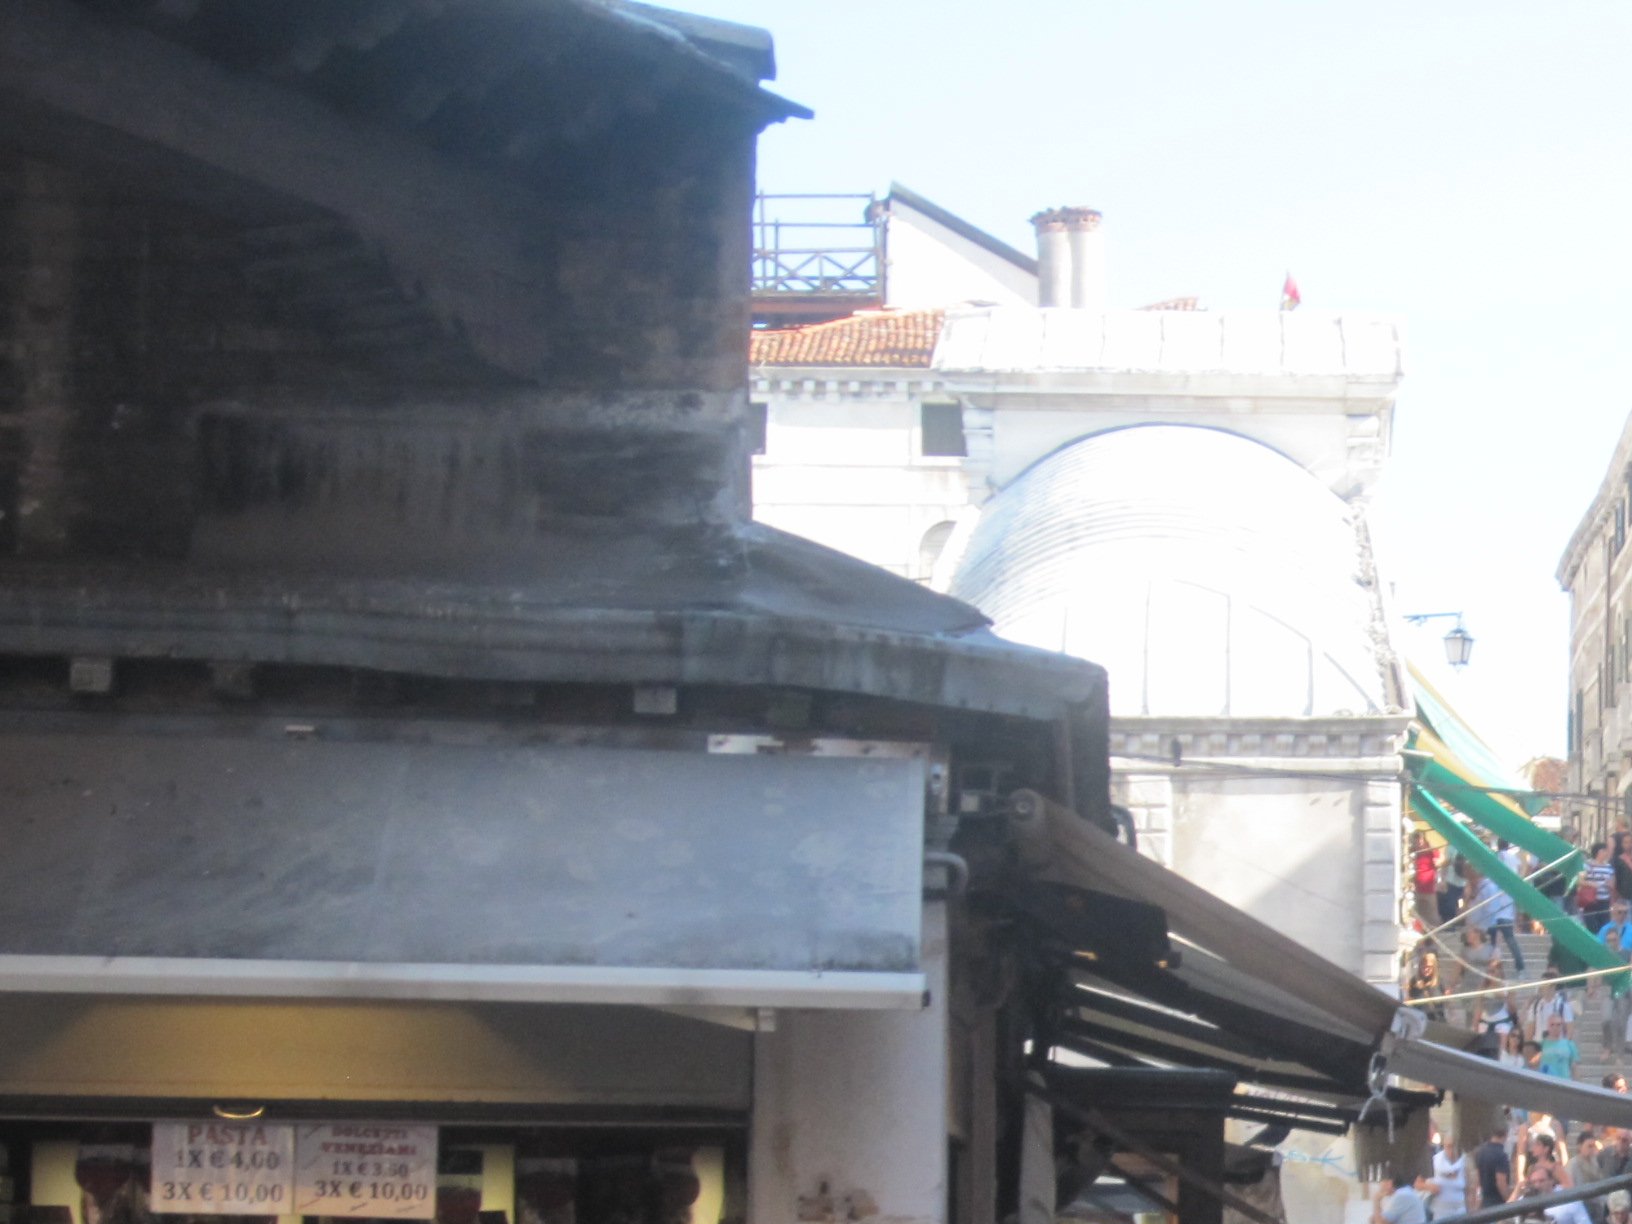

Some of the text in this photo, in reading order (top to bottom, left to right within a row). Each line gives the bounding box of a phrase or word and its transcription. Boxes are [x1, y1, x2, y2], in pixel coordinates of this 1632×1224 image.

[187, 1123, 267, 1146] PASTA
[162, 1182, 283, 1204] 3X € 10,00
[315, 1180, 428, 1203] 3X € 10,00
